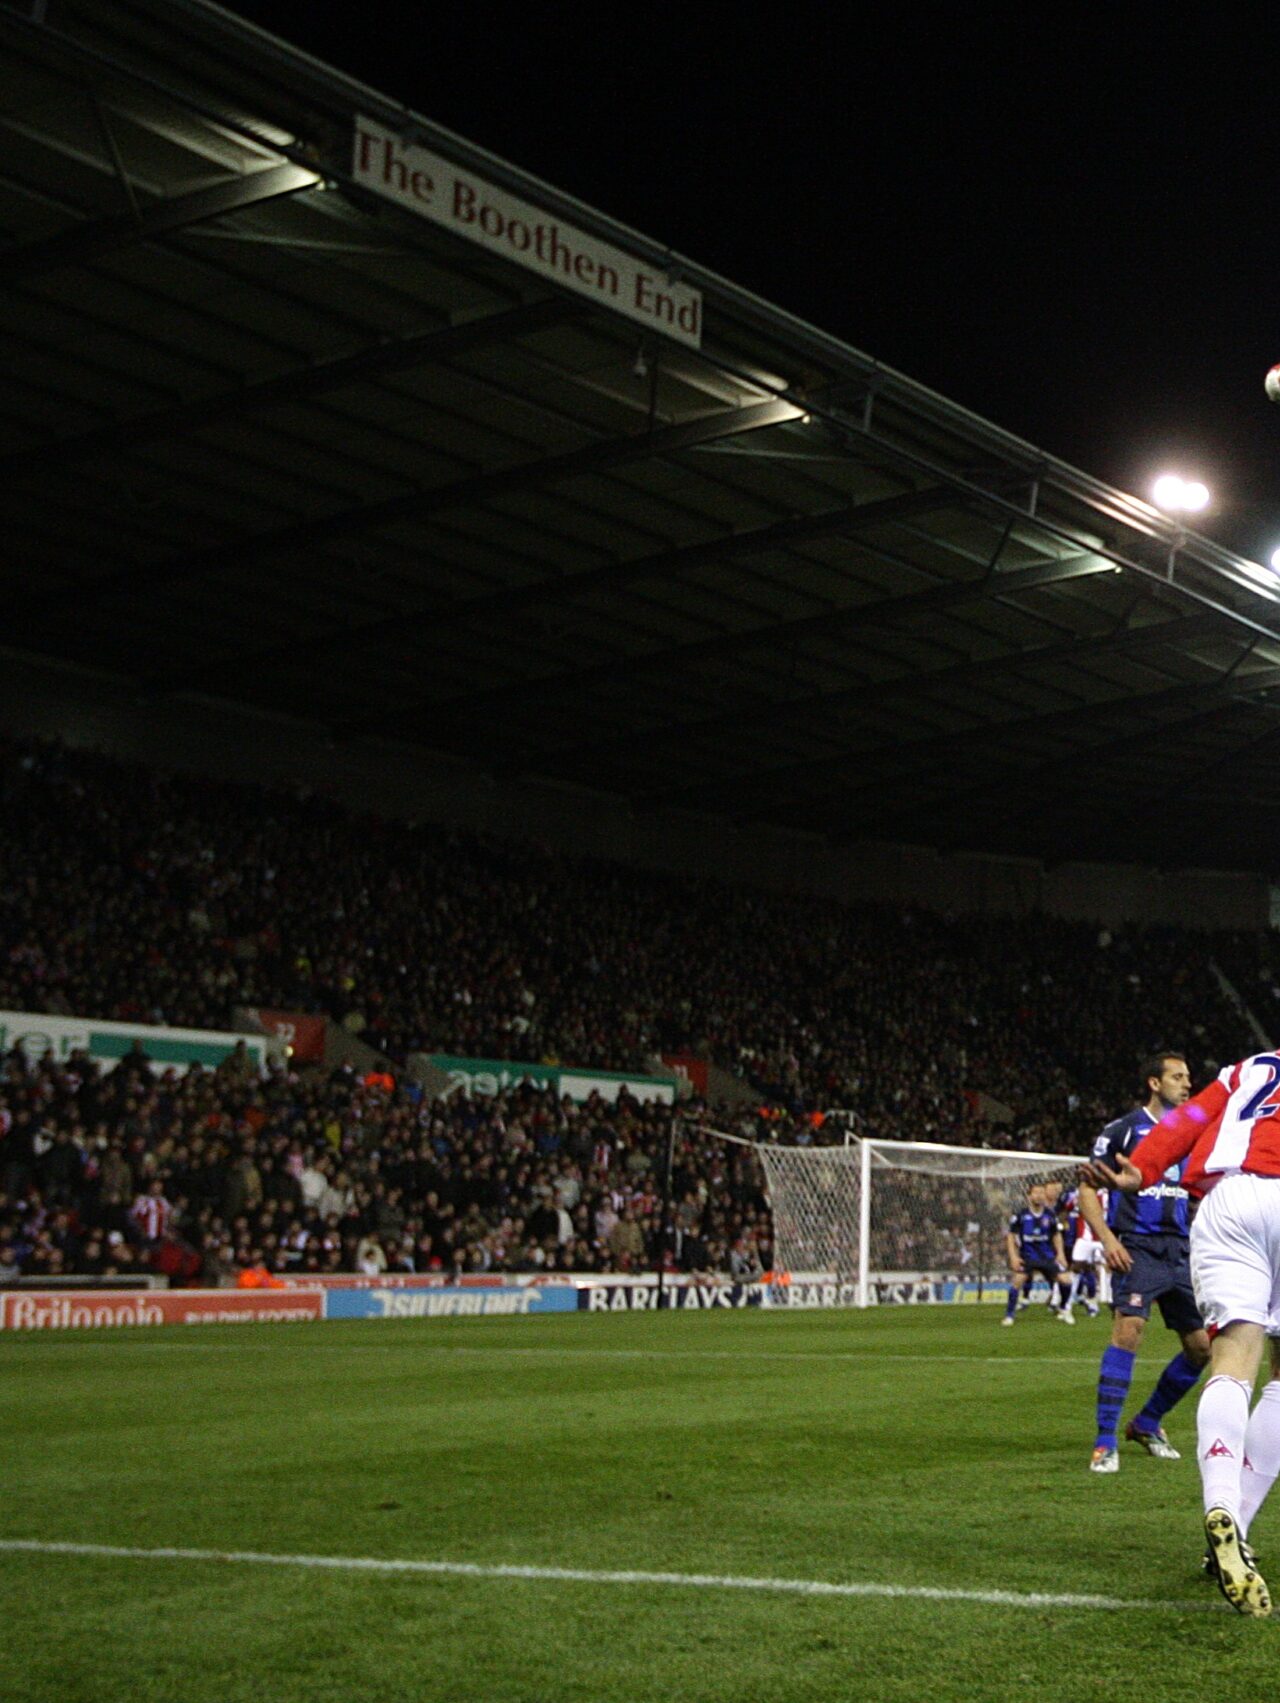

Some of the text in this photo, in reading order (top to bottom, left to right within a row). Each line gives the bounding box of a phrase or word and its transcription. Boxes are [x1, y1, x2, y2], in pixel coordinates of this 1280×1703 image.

[359, 130, 699, 336] The Boothen End
